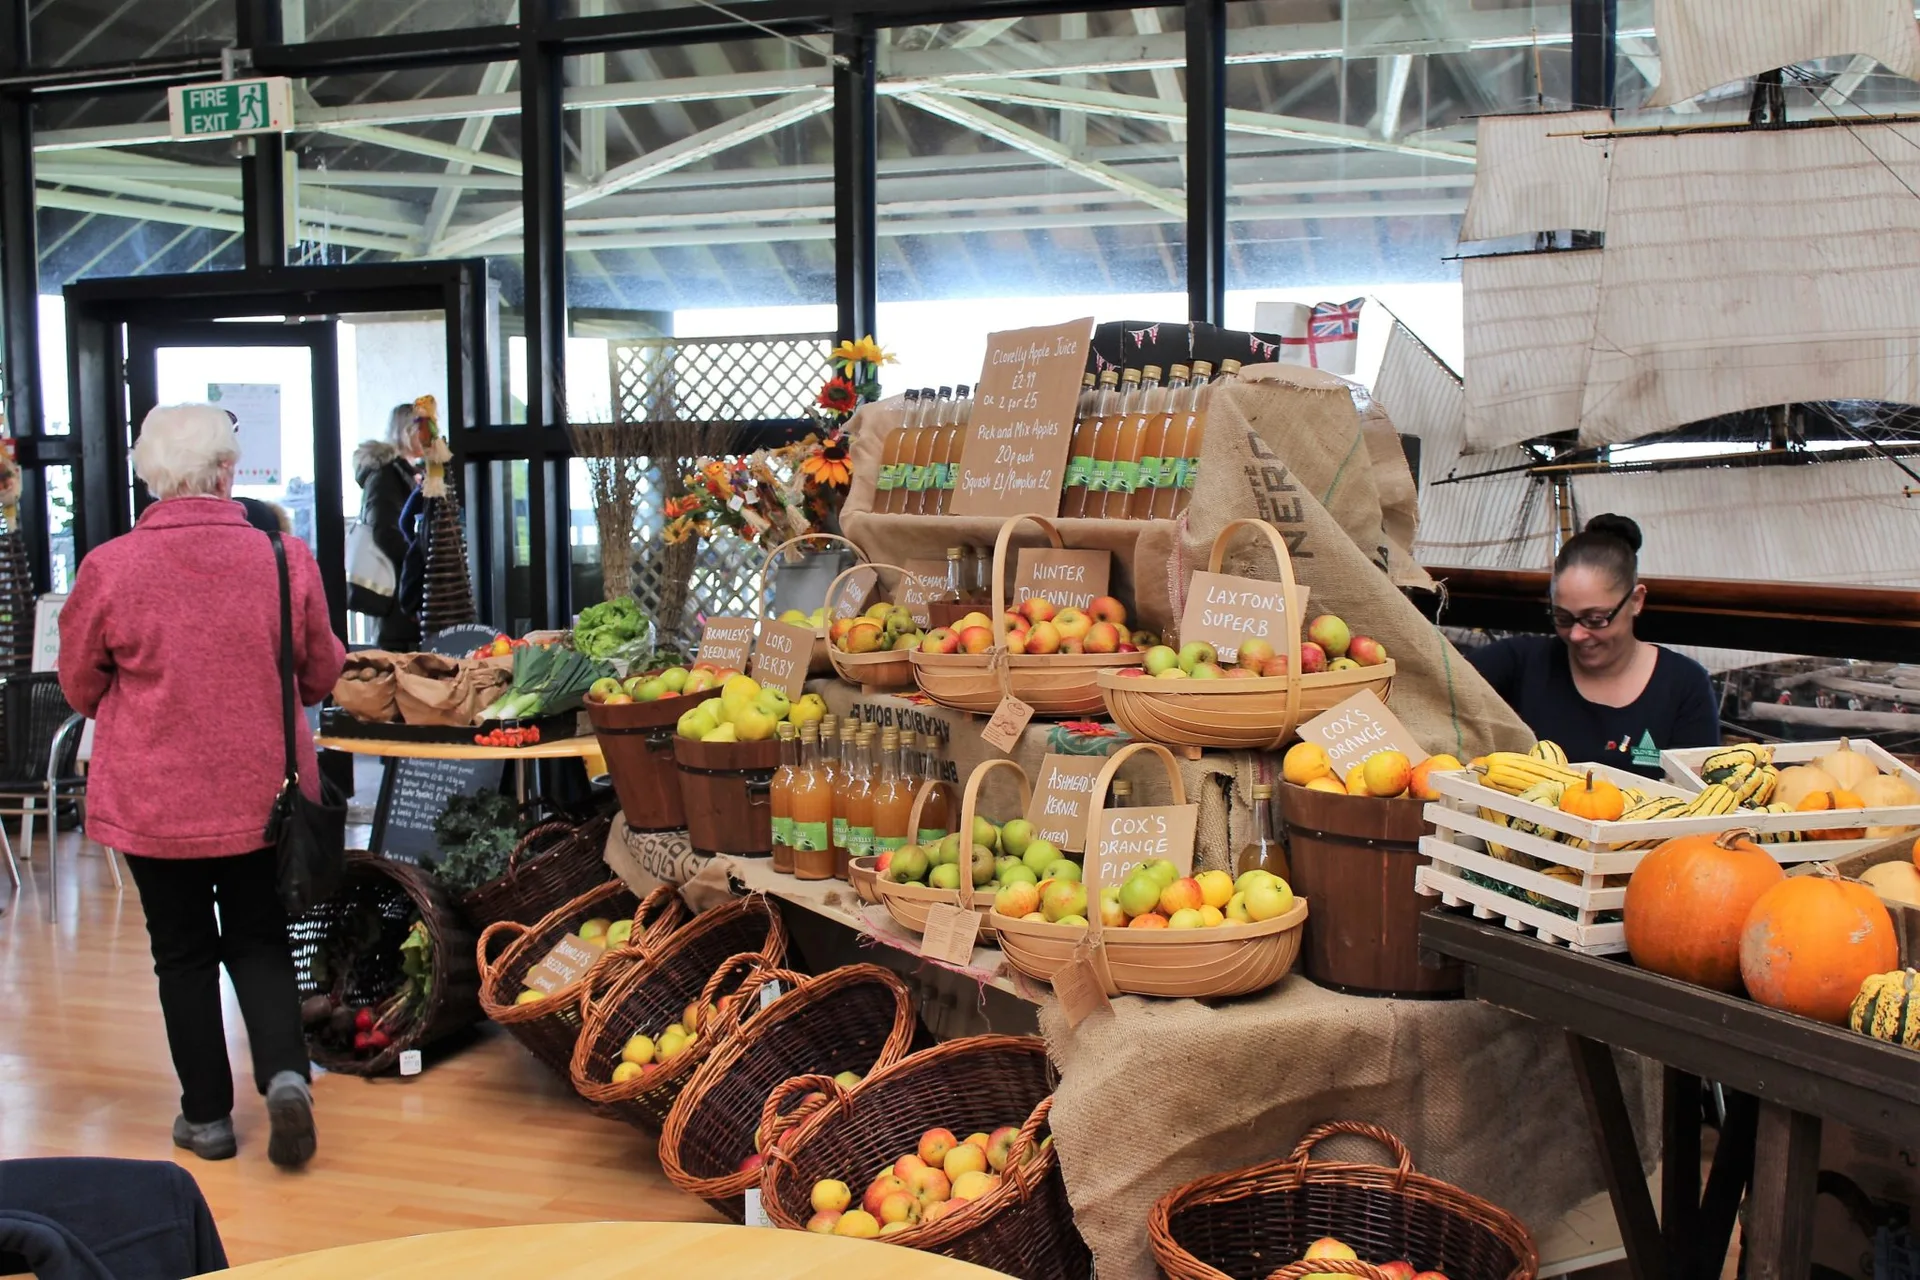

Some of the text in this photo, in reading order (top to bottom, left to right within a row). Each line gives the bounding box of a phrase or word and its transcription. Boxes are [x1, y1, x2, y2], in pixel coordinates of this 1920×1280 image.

[189, 88, 228, 109] FIRE
[190, 112, 229, 134] EXIT
[992, 336, 1077, 374] Clovelly Apple Juice
[998, 396, 1005, 410] 2
[1006, 396, 1021, 412] for
[1023, 391, 1040, 410] £5
[977, 417, 1059, 440] Pick and Mix Apples
[994, 444, 1035, 466] 20p each
[961, 469, 991, 497] Squash
[1037, 468, 1053, 491] £2
[904, 571, 949, 591] RSEMARY
[1032, 562, 1086, 583] WINTER
[1206, 585, 1286, 613] LAXTON'S
[1202, 608, 1269, 637] SUPERB
[705, 624, 750, 644] BRAMLEY'S
[765, 631, 793, 654] LORD
[702, 645, 742, 664] SEEDLING
[757, 653, 795, 680] DERBY
[1321, 708, 1371, 741] COX'S
[1327, 720, 1388, 760] ORANGE
[1047, 766, 1098, 794] ASHMEAD'S
[1043, 794, 1079, 818] KERNAL
[1110, 814, 1167, 836] COX'S
[1099, 837, 1169, 857] ORANGE
[1100, 861, 1142, 880] PIP
